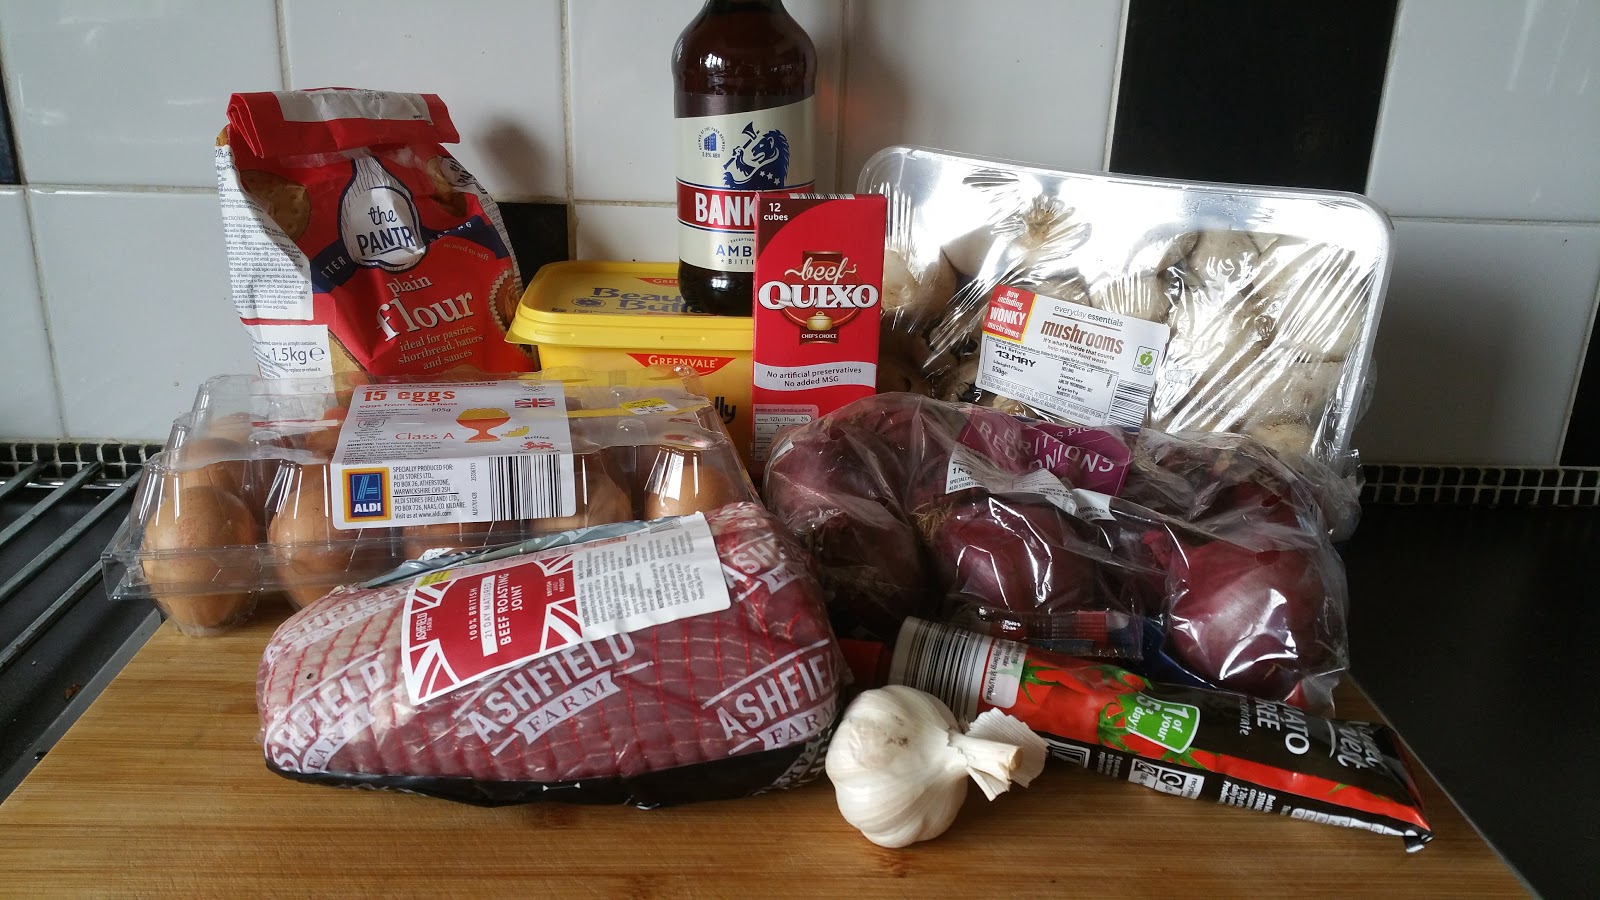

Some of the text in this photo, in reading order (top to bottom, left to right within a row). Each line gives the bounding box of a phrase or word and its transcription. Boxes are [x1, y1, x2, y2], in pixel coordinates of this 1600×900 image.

[368, 206, 397, 225] the
[768, 202, 781, 212] 12
[763, 213, 789, 221] cubes
[451, 243, 467, 252] need
[477, 250, 489, 261] sift
[716, 244, 752, 257] AMB
[785, 257, 857, 285] beef
[386, 274, 433, 298] plain
[758, 281, 879, 310] QUIXO
[1006, 290, 1020, 298] now
[997, 295, 1023, 311] including
[376, 292, 475, 342] flour
[989, 306, 1027, 326] WONKY
[1054, 304, 1124, 328] everyday essentials
[987, 321, 1020, 338] mushrooms
[1040, 320, 1125, 355] mushrooms
[400, 337, 425, 352] ideal
[425, 334, 441, 345] for
[271, 347, 307, 365] 1.5kg
[399, 341, 455, 365] shortbread,
[423, 349, 473, 370] and sauces
[648, 354, 716, 368] GREENVALE
[995, 350, 1036, 368] 13.MAY
[766, 366, 862, 379] No artificial preservatives
[796, 377, 820, 387] added
[821, 375, 839, 383] MSG
[363, 390, 456, 403] 15 eggs
[395, 432, 438, 440] Class
[442, 432, 455, 440] A
[979, 421, 1019, 461] RED
[393, 487, 431, 495] WARWICKSHIRE
[424, 495, 448, 503] (IRELAND)
[353, 502, 382, 513] ALDI
[511, 585, 523, 612] JOINT
[468, 587, 478, 641] 100% BRITISH
[483, 582, 492, 639] 21 DAY MATURED
[498, 573, 512, 646] BEEF ROASTING
[416, 612, 428, 641] ASHFIELD
[468, 632, 636, 744] ASHFIELD
[526, 678, 609, 735] FARM
[1136, 695, 1161, 711] 5
[1157, 714, 1173, 741] your
[1163, 707, 1190, 734] 1 of
